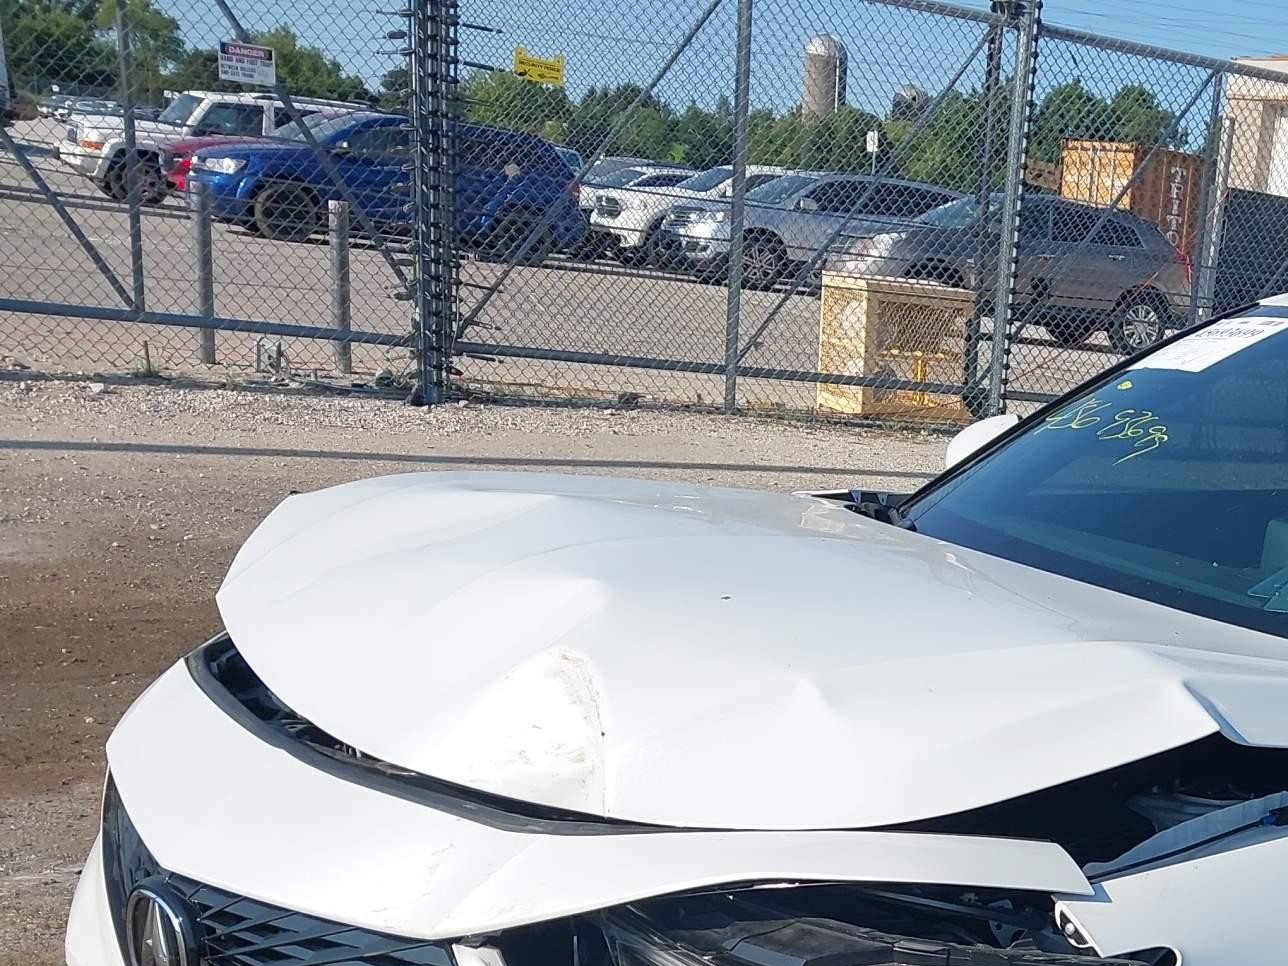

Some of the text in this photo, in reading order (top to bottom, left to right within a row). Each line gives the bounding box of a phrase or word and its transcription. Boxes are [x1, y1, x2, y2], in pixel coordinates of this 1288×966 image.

[228, 45, 265, 58] DANGER
[518, 60, 561, 73] SECURITY FENCE
